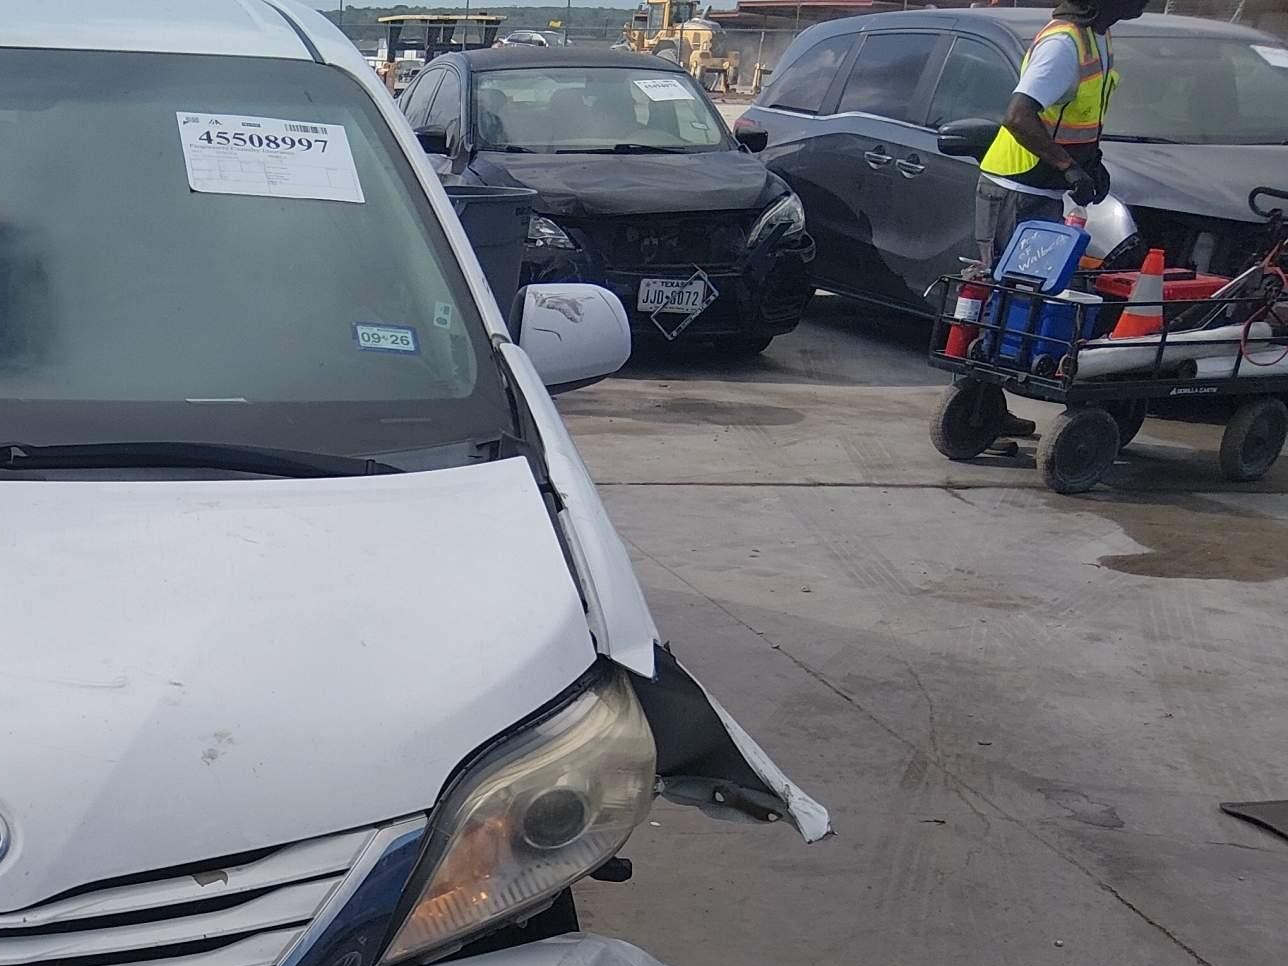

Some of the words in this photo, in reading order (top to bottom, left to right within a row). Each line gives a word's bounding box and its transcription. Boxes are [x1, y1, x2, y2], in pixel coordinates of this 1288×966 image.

[198, 129, 328, 153] 45508997
[360, 331, 382, 344] 09
[389, 334, 410, 346] 26
